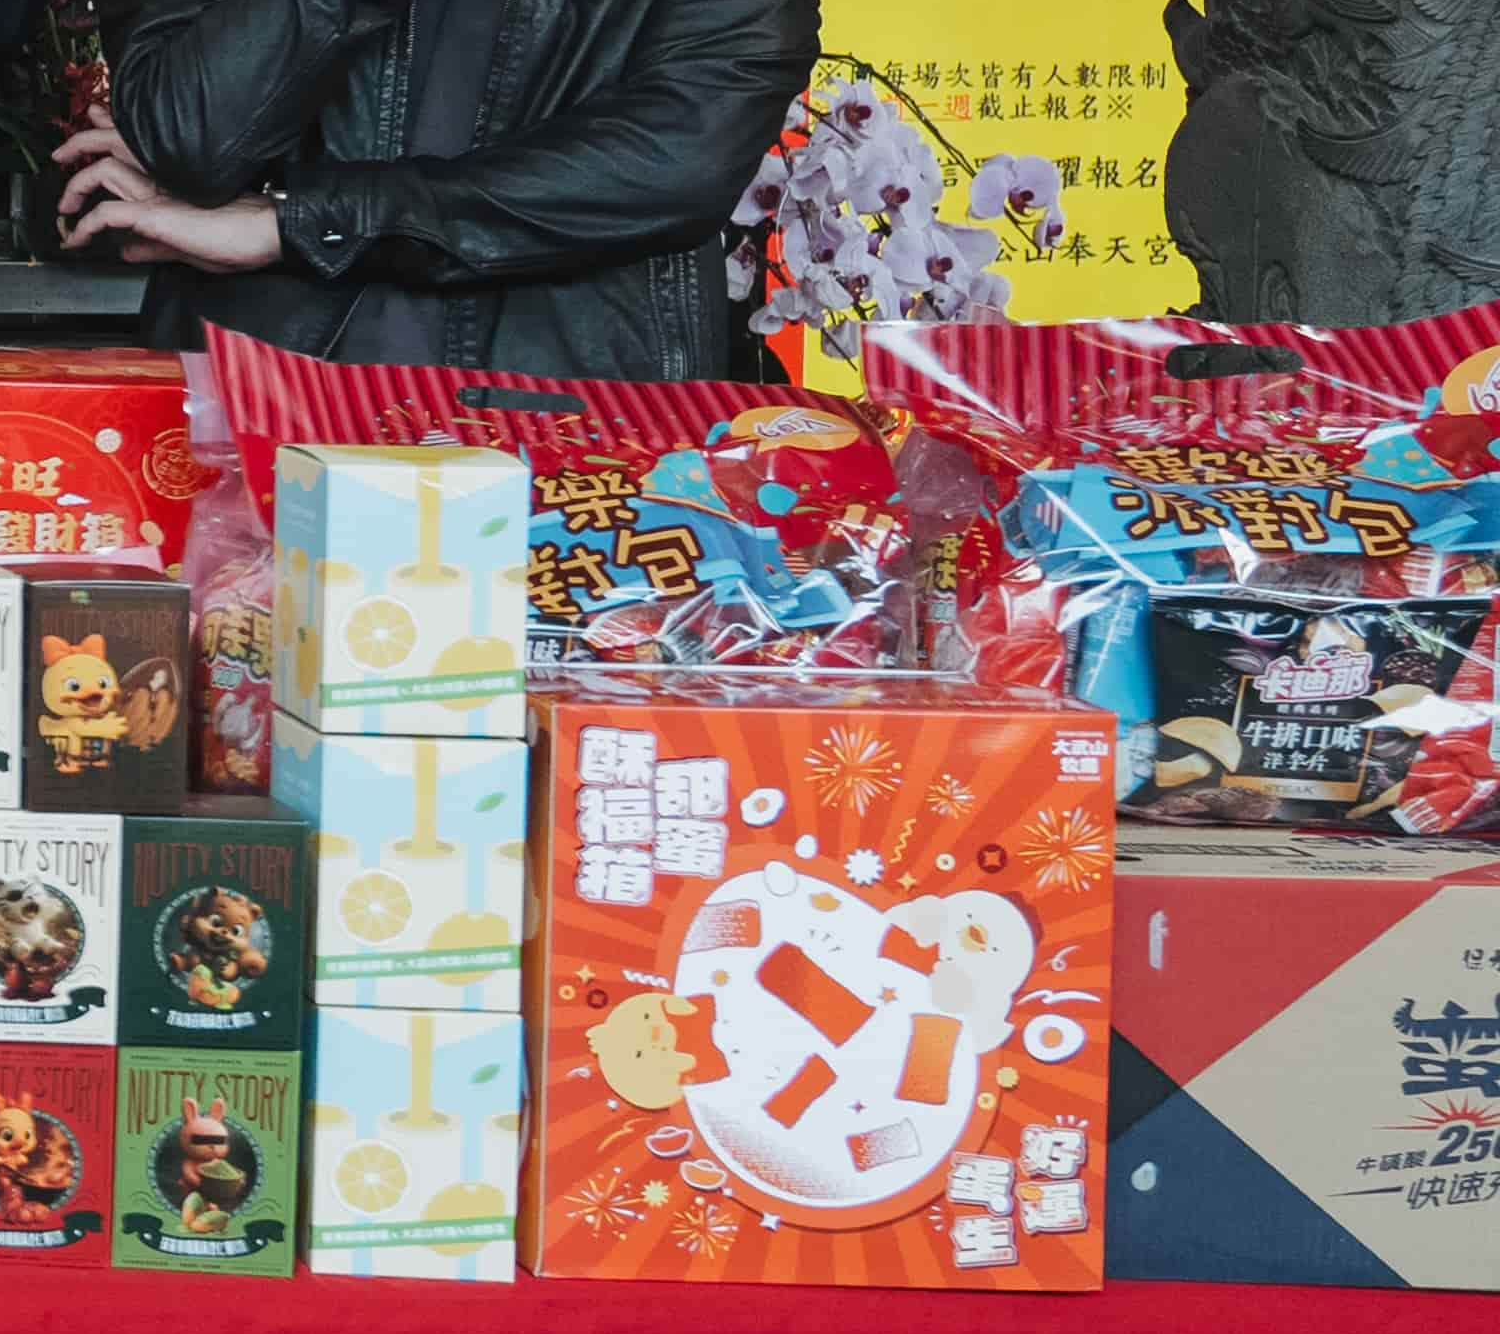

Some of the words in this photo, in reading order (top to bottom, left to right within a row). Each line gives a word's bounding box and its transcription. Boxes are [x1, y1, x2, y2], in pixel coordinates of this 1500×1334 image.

[533, 469, 637, 531] 樂
[1105, 476, 1414, 558] 派對包
[1254, 651, 1373, 704] 卡迪那
[1243, 720, 1363, 751] 牛排口味
[37, 838, 110, 908] STORY
[133, 840, 213, 908] NUTTY
[219, 842, 296, 912] STORY
[126, 1068, 208, 1135] NUTTY
[214, 1073, 291, 1143] STORY
